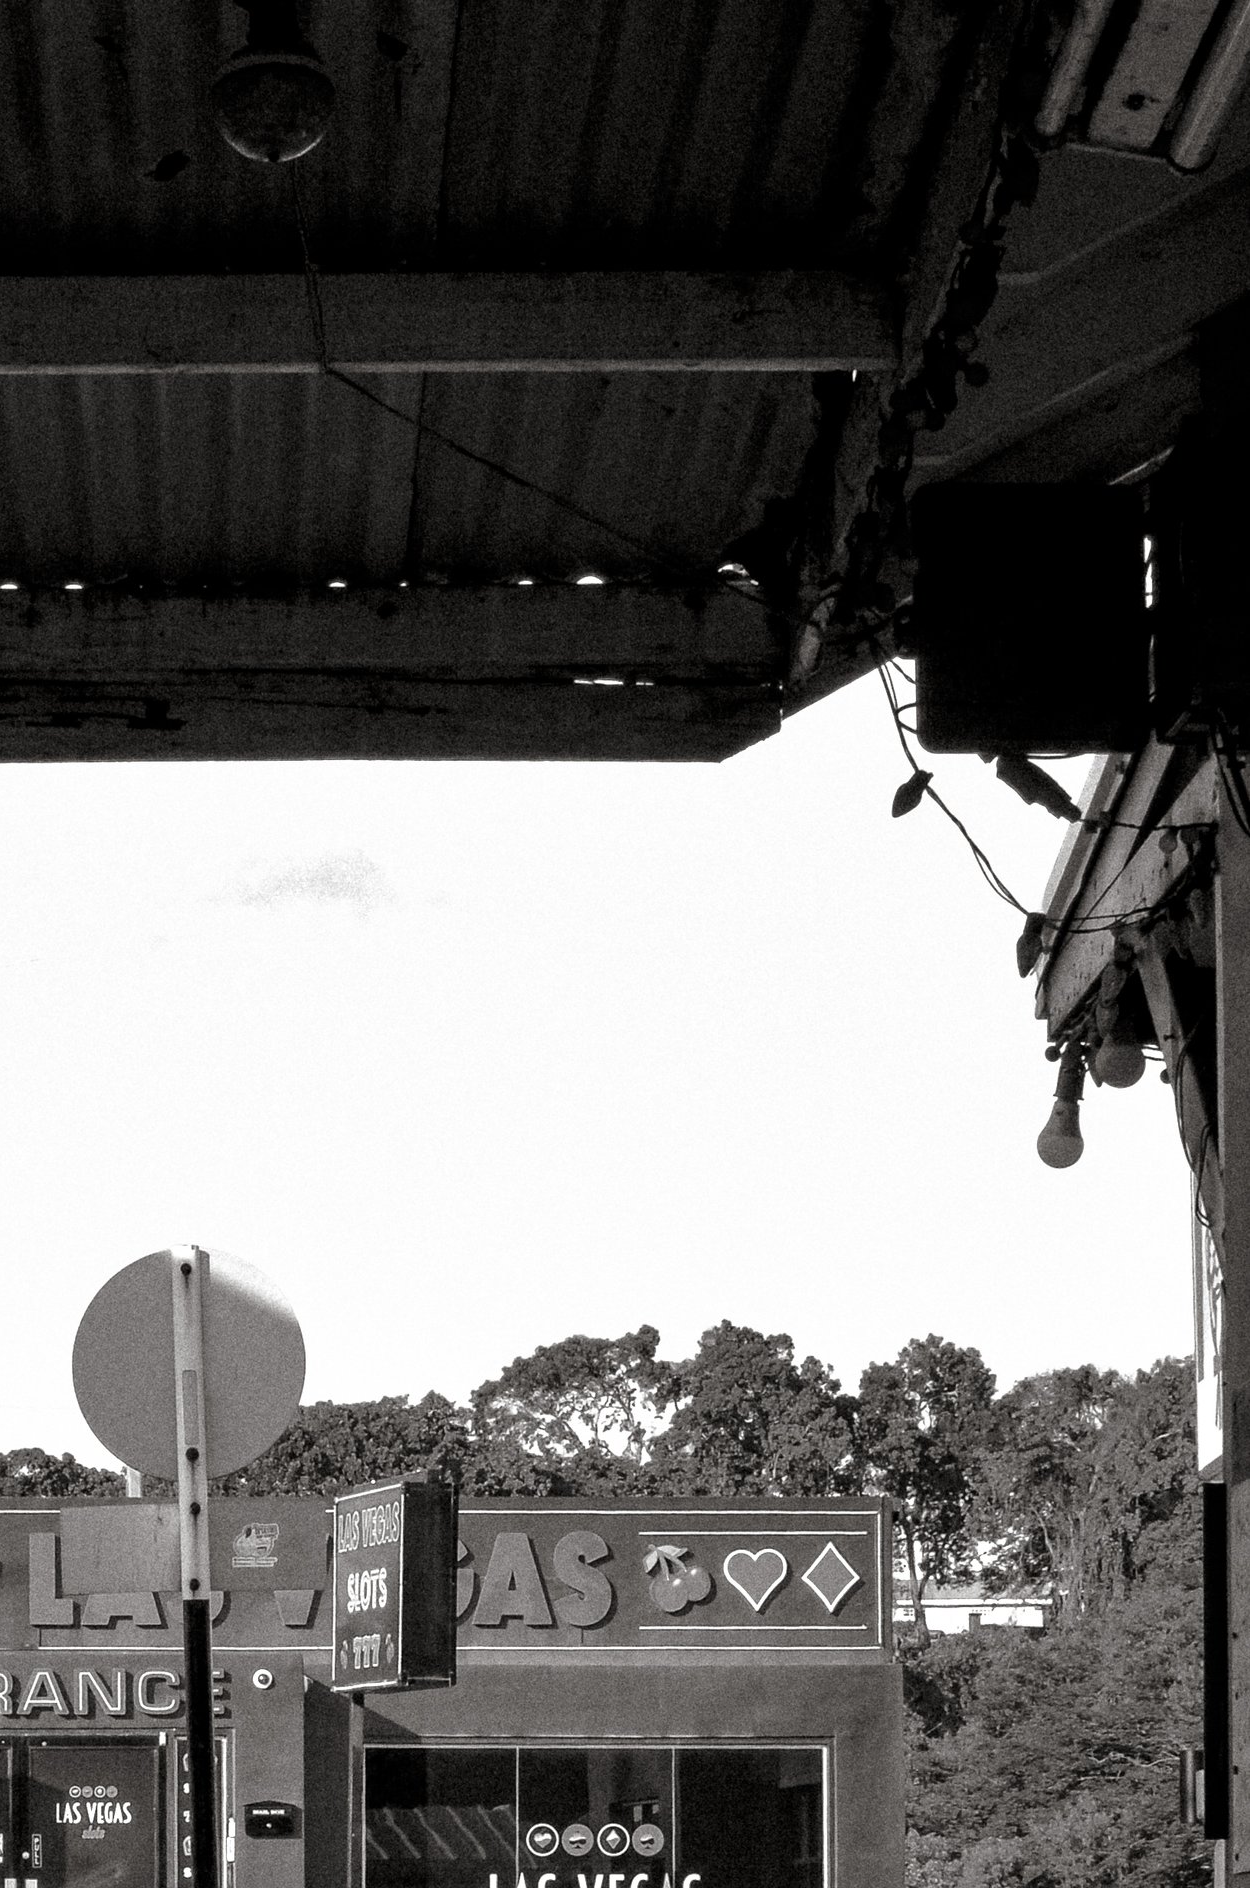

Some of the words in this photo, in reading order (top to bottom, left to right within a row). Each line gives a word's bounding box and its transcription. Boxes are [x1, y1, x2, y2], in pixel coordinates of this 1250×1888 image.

[337, 1511, 360, 1554] LAS
[361, 1501, 400, 1548] VEGAS
[347, 1567, 388, 1613] SLOTS
[352, 1633, 381, 1670] 777
[56, 1801, 81, 1824] LAS
[86, 1801, 132, 1824] VEGAS
